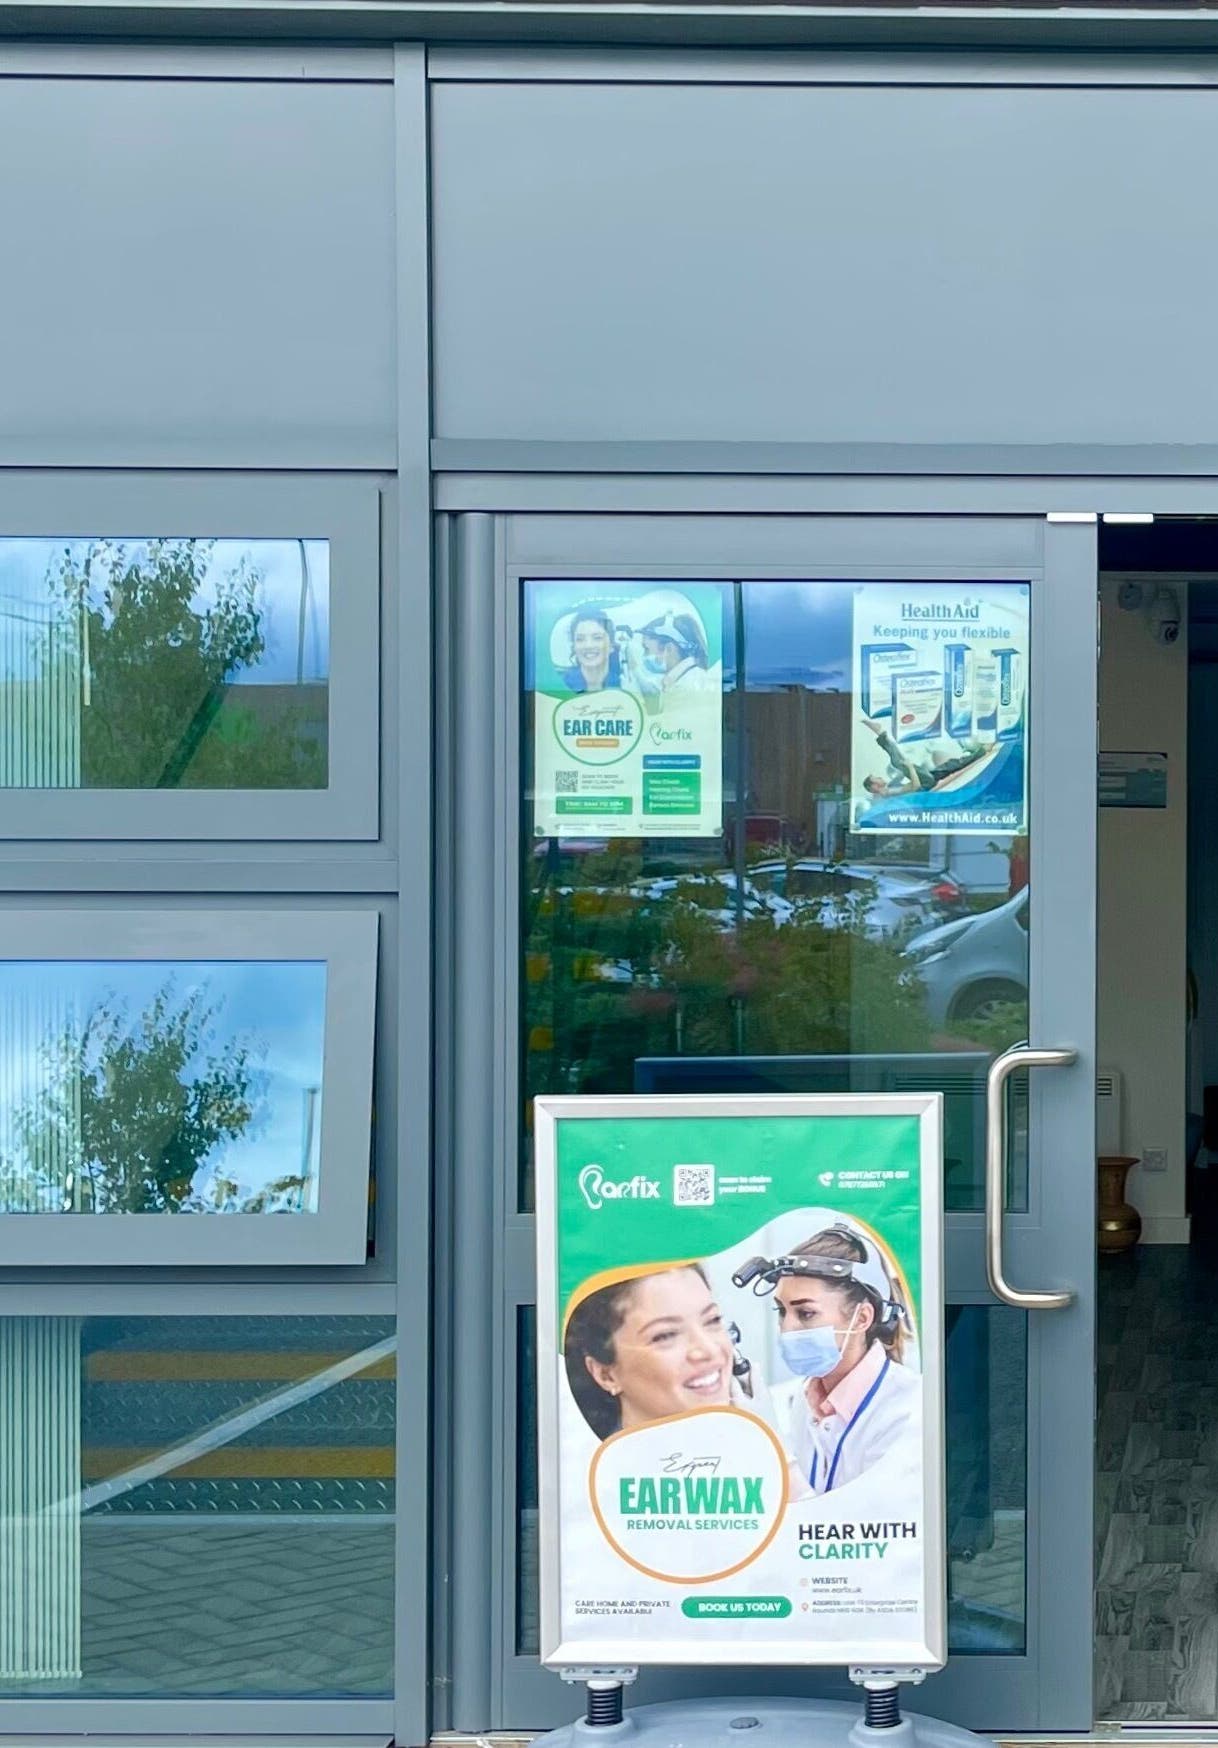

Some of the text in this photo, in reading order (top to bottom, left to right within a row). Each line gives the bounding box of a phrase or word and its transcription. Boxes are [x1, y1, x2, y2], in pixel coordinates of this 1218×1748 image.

[901, 602, 980, 618] HealthAid
[873, 625, 1010, 640] Keeping you flexible
[563, 719, 633, 736] EAR CARE
[889, 812, 1017, 824] www.HealthAid.co.uk
[619, 1477, 765, 1514] EARWAX
[627, 1519, 759, 1530] REMOVAL SERVICES
[799, 1522, 916, 1540] HEAR WITH
[799, 1542, 888, 1559] CLARITY
[812, 1577, 848, 1585] WEBSITE
[575, 1607, 611, 1615] SERVICES
[698, 1601, 782, 1612] BOOK US TODAY
